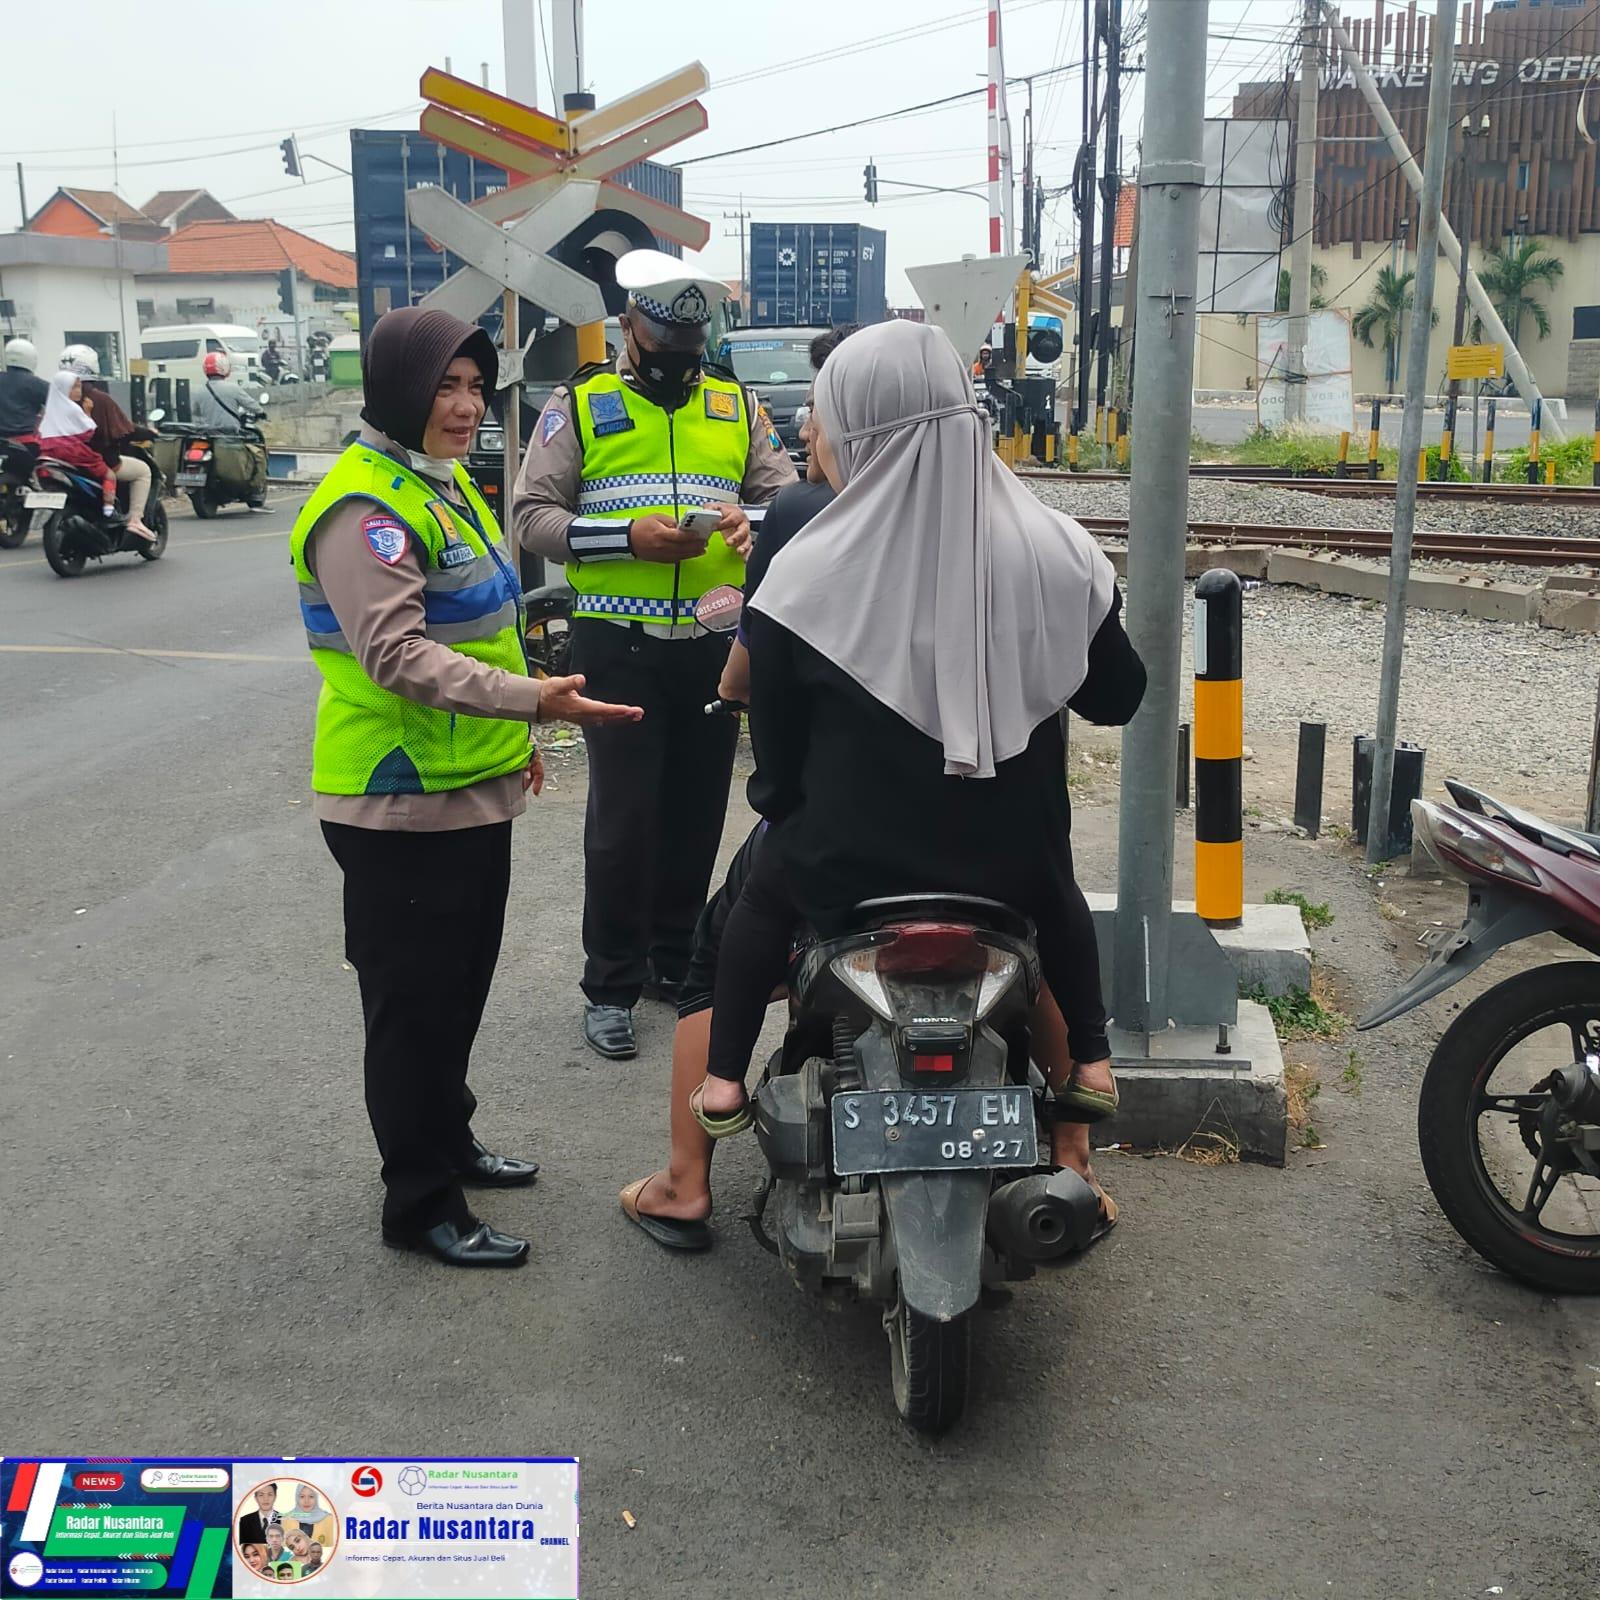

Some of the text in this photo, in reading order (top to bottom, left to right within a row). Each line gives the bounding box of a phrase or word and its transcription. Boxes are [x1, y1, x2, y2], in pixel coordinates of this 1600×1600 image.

[844, 1094, 1021, 1129] S 3457 EW
